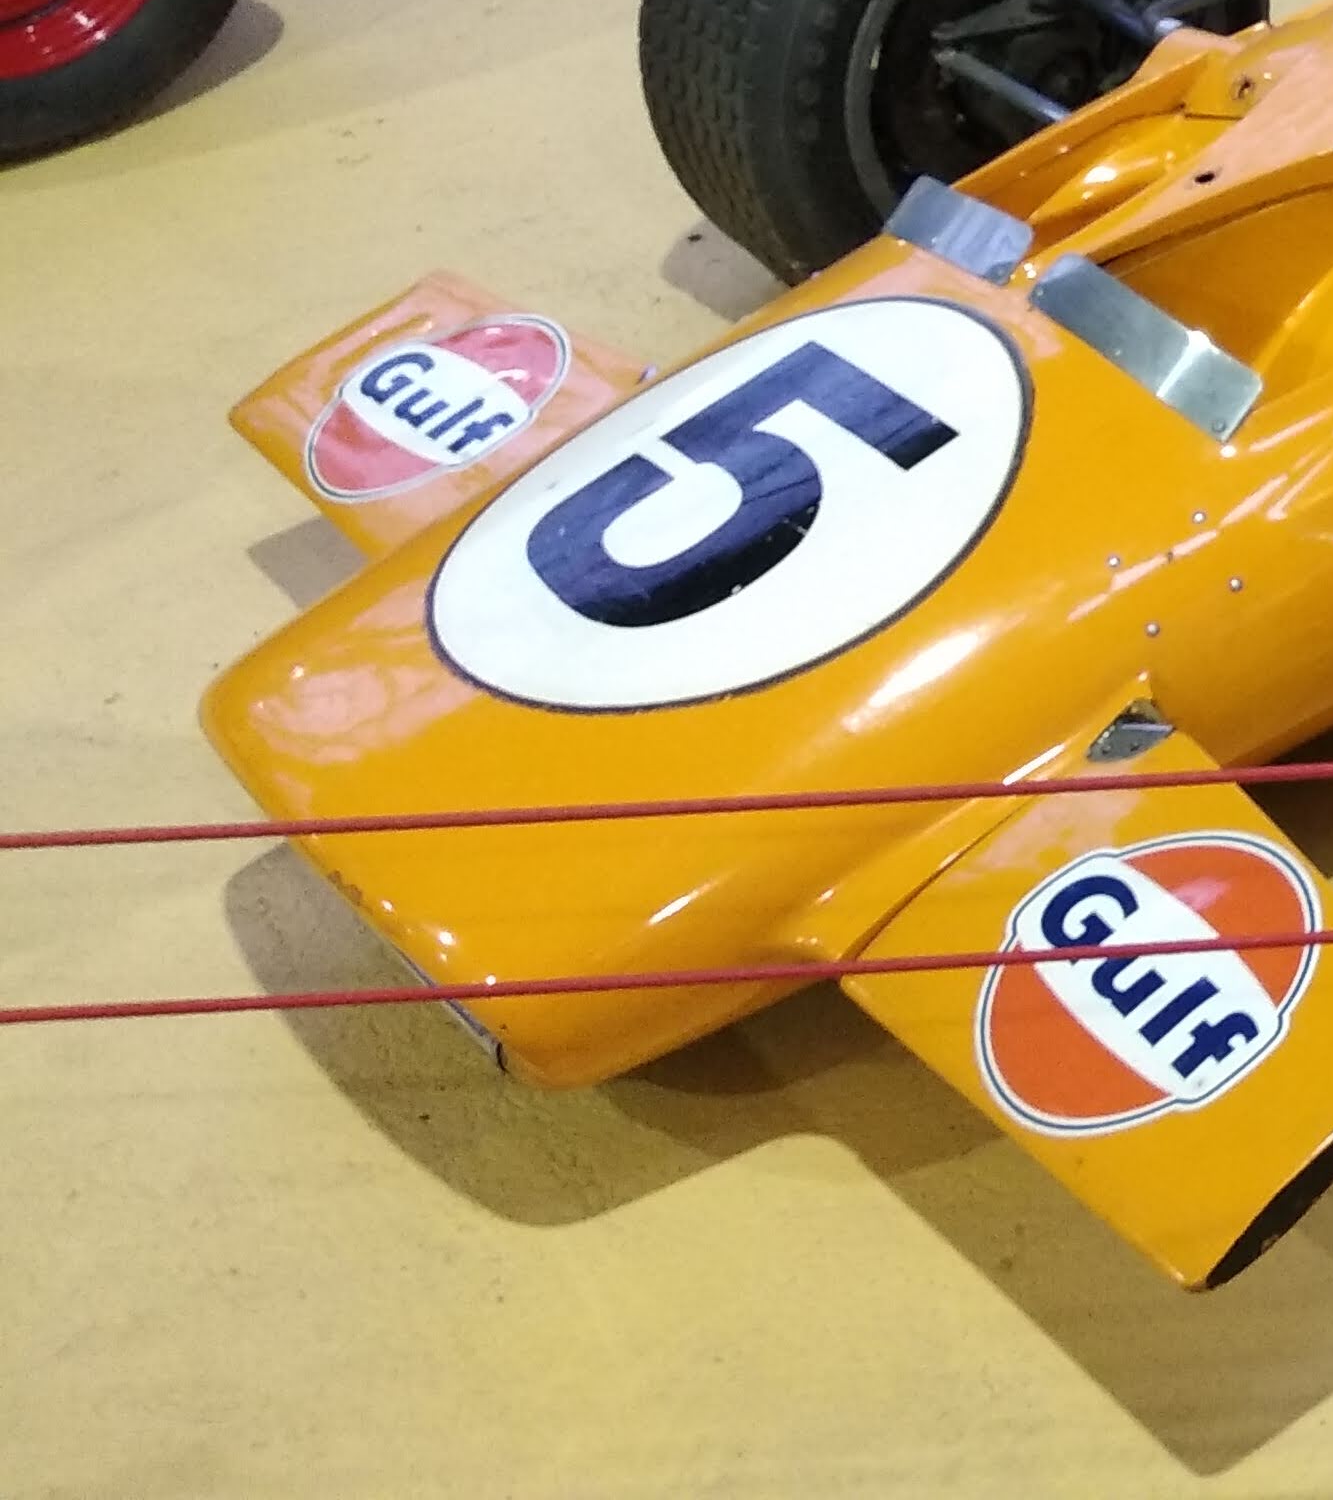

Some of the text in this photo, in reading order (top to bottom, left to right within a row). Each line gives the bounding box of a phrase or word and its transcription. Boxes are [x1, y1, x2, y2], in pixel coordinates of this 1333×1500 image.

[359, 352, 515, 453] Gulf
[526, 340, 961, 627] 5
[1040, 874, 1260, 1079] Gulf
